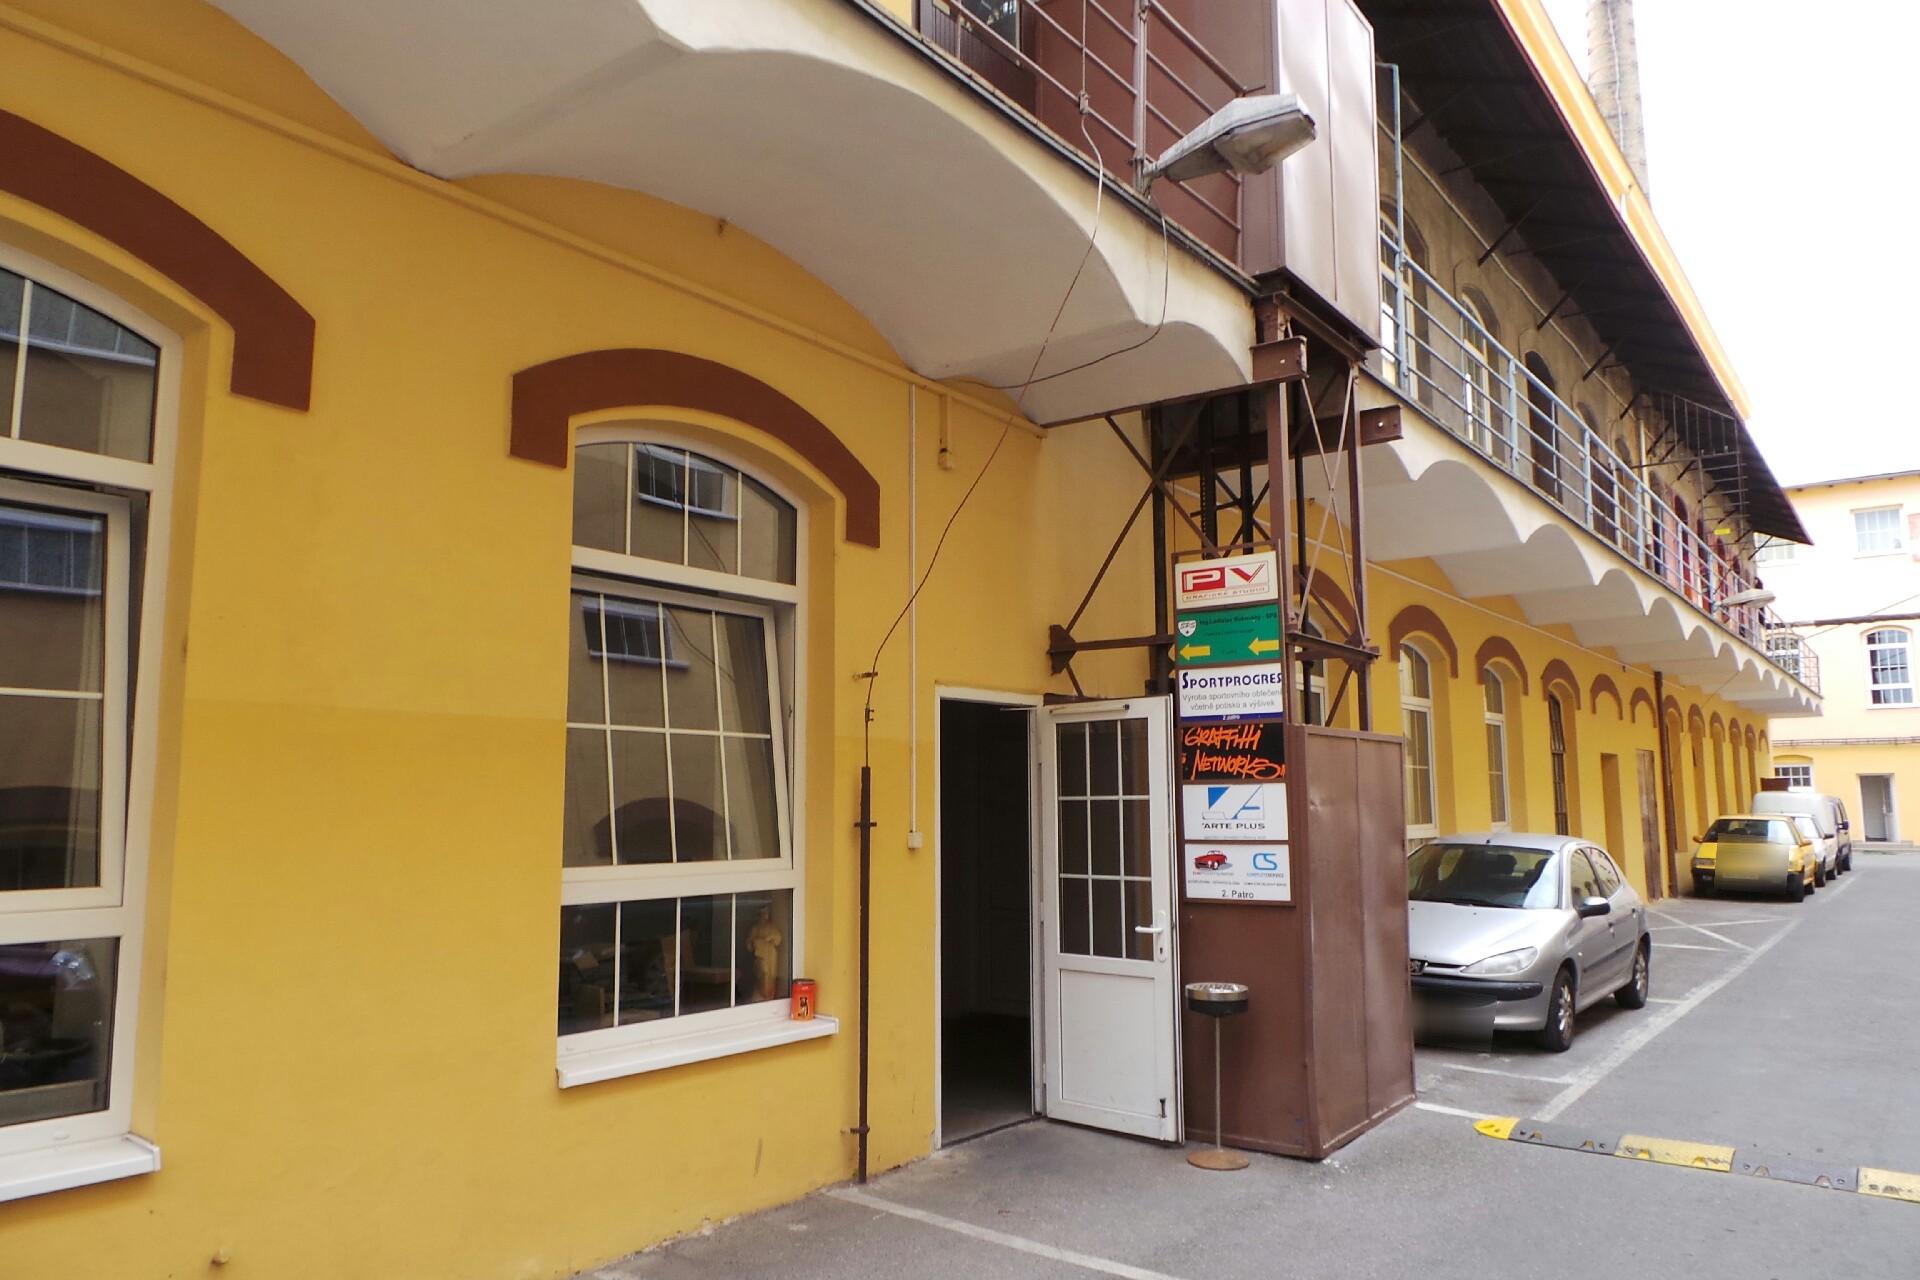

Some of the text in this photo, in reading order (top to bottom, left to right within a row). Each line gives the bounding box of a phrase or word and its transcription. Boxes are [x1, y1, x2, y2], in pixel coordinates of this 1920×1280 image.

[1183, 563, 1265, 591] PV
[1236, 822, 1266, 830] PLUS
[1231, 890, 1255, 899] Patro
